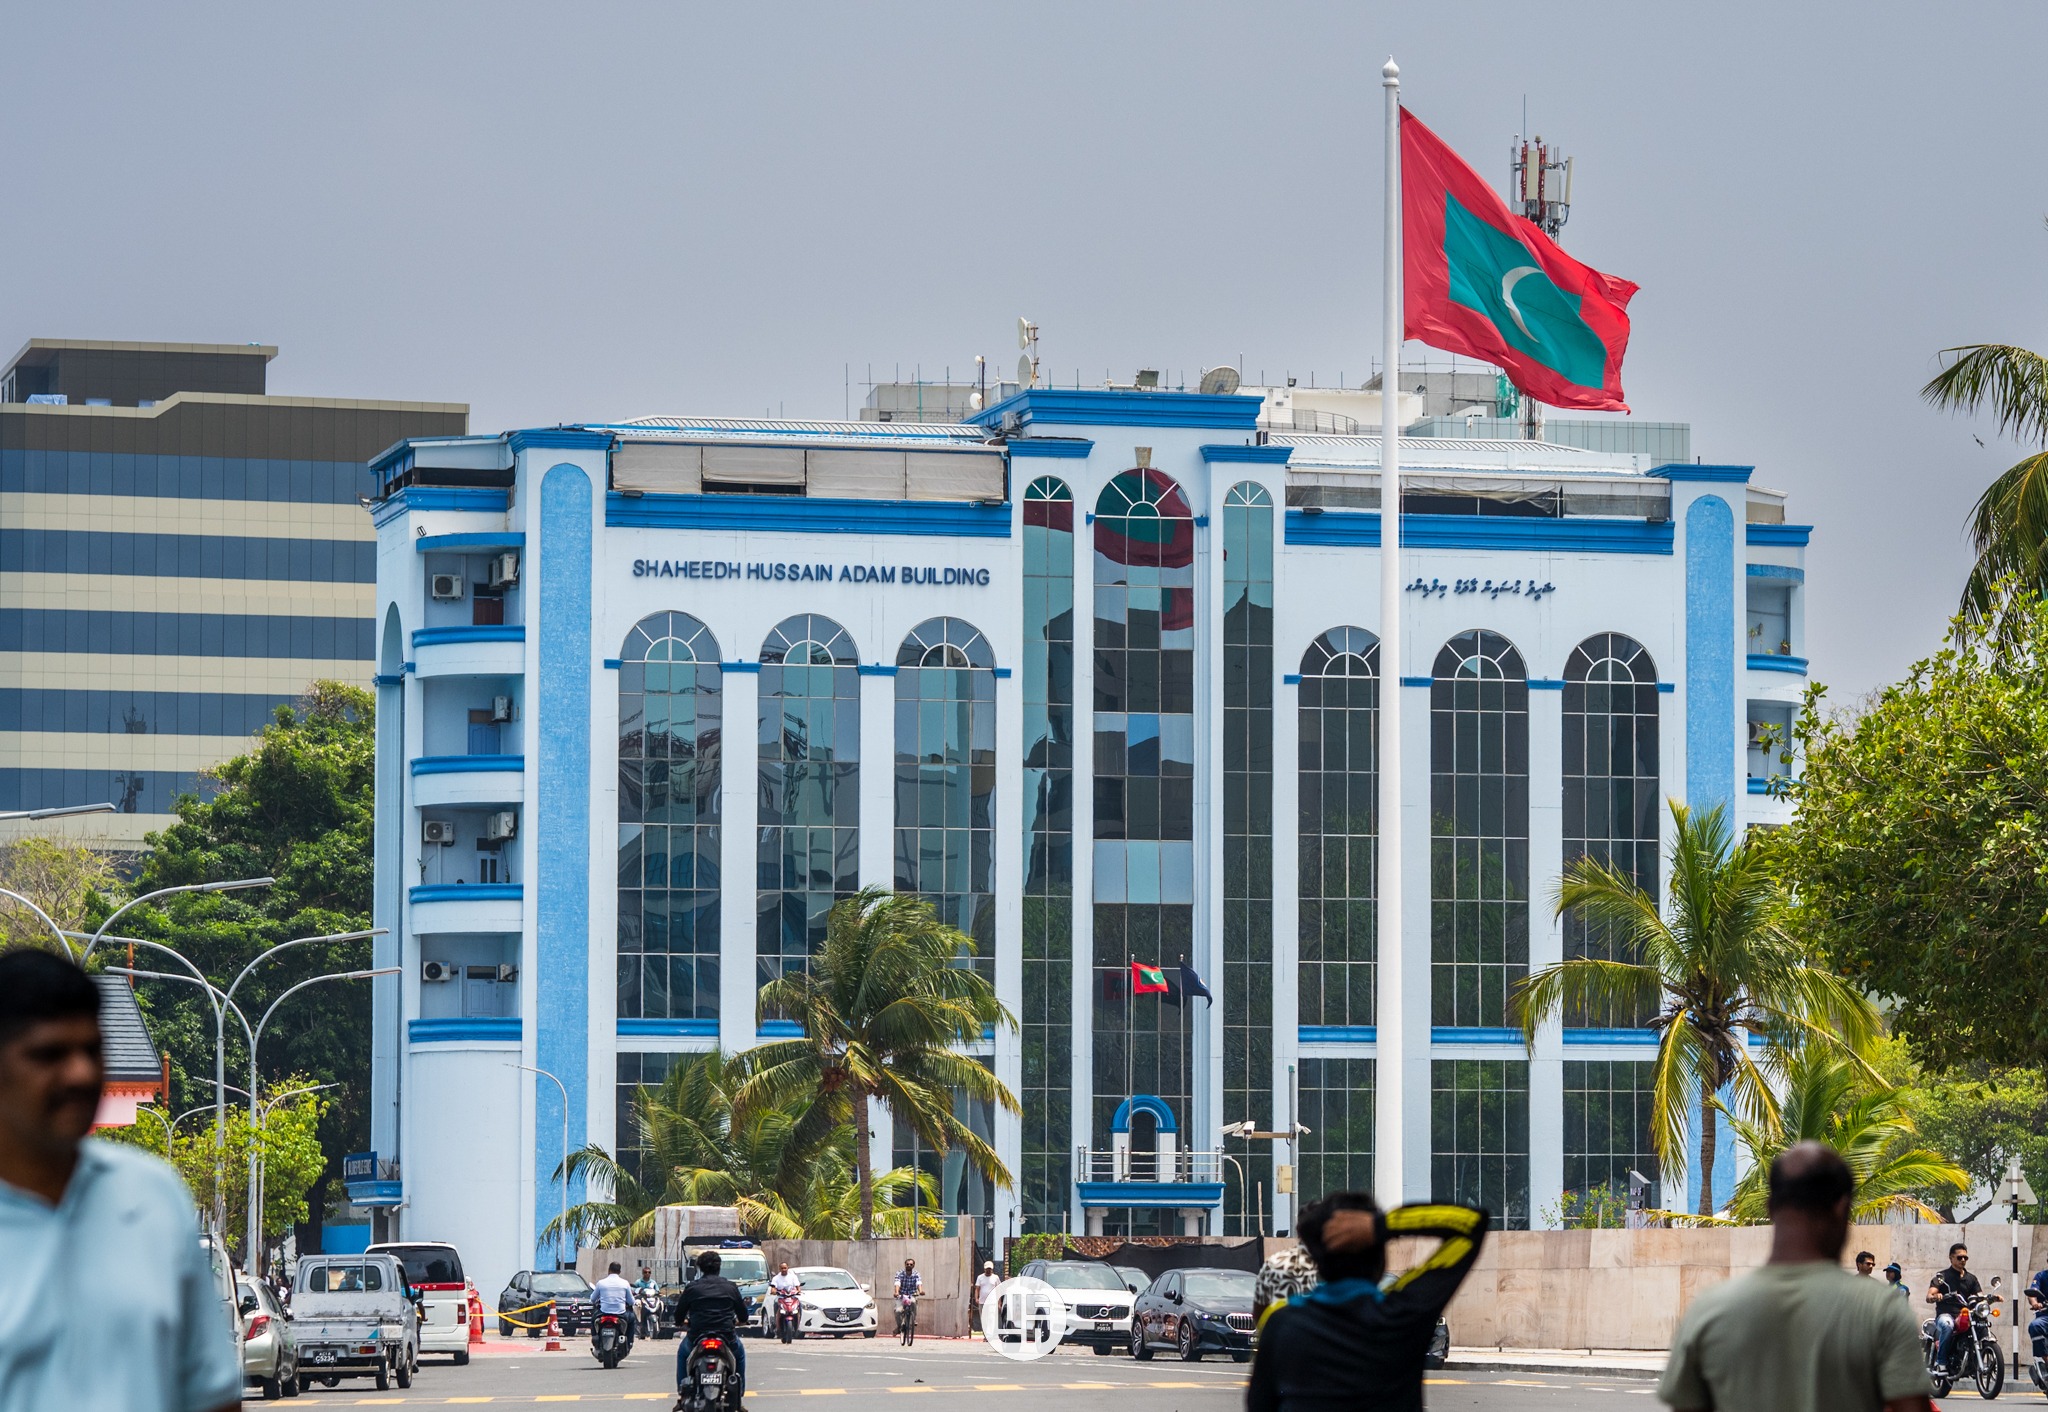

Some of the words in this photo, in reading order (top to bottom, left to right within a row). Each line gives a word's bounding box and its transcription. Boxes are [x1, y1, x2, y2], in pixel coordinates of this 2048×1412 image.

[632, 559, 741, 580] SHAHEEDH
[746, 563, 833, 582] HUSSAIN
[838, 565, 896, 583] ADAM
[901, 566, 990, 586] BUILDING
